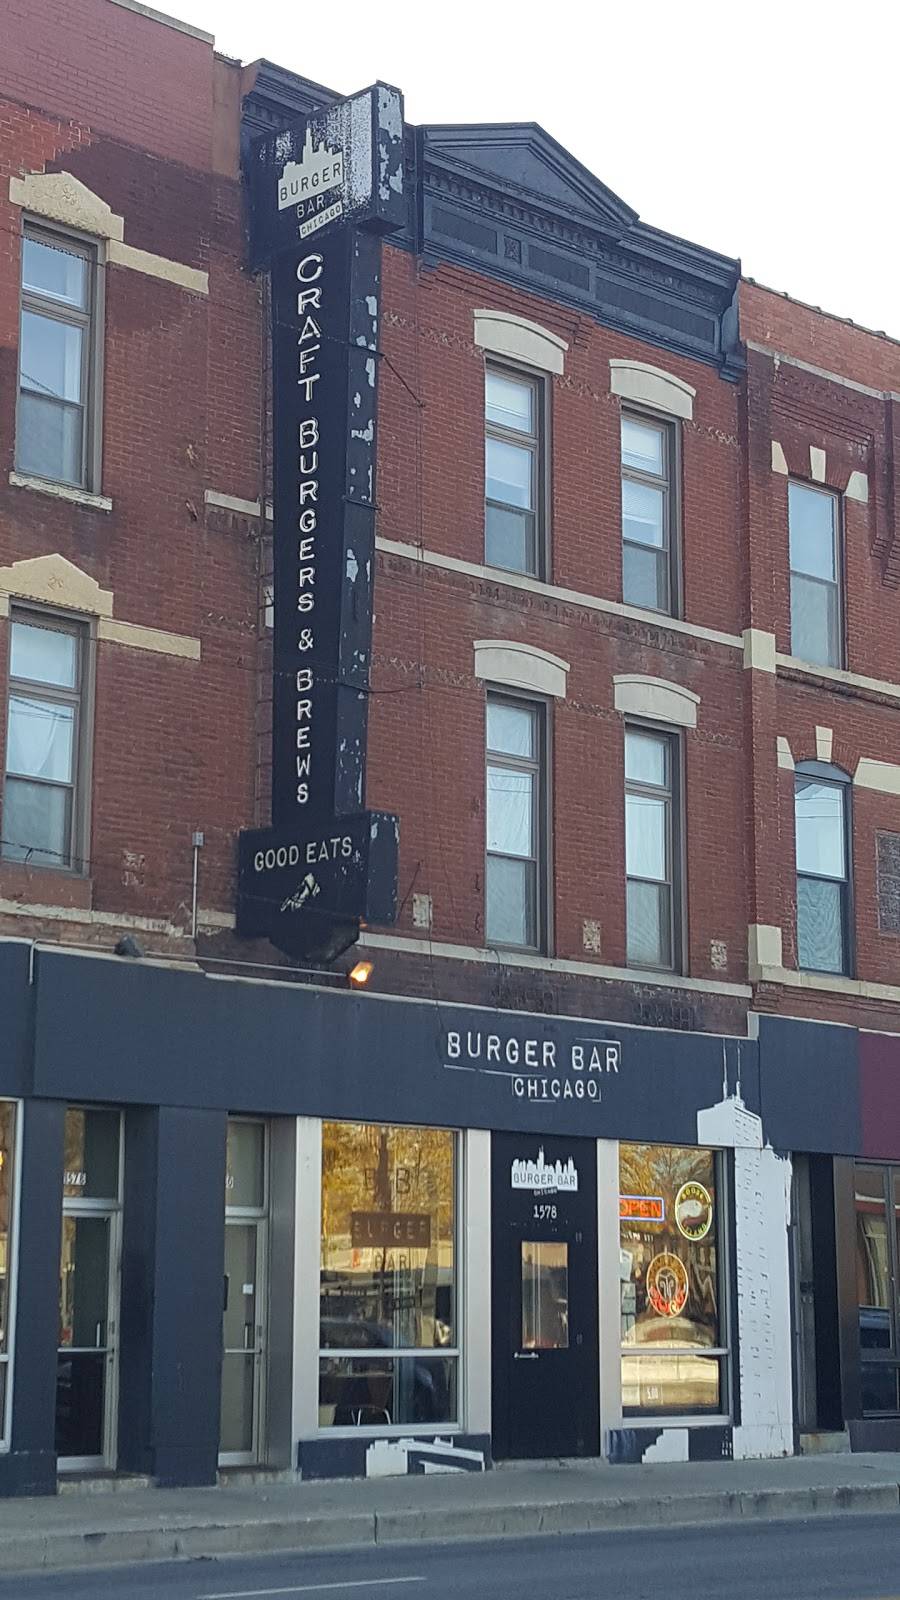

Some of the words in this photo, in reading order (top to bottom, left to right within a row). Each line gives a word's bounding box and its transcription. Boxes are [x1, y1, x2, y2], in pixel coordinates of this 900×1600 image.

[280, 162, 341, 202] BURGER
[296, 194, 325, 219] BAR
[301, 204, 341, 235] CHICAGO
[296, 253, 323, 402] CRAFT
[298, 418, 319, 612] BURGERS
[298, 629, 314, 651] &
[296, 669, 314, 804] BREWS
[254, 844, 299, 872] GOOD
[306, 836, 353, 864] EATS
[447, 1031, 556, 1068] BURGER
[571, 1046, 619, 1073] BAR
[514, 1077, 598, 1099] CHICAGO
[513, 1172, 553, 1185] BURGER
[557, 1175, 576, 1187] BAR
[533, 1204, 557, 1219] 1578
[619, 1198, 662, 1217] OPEN
